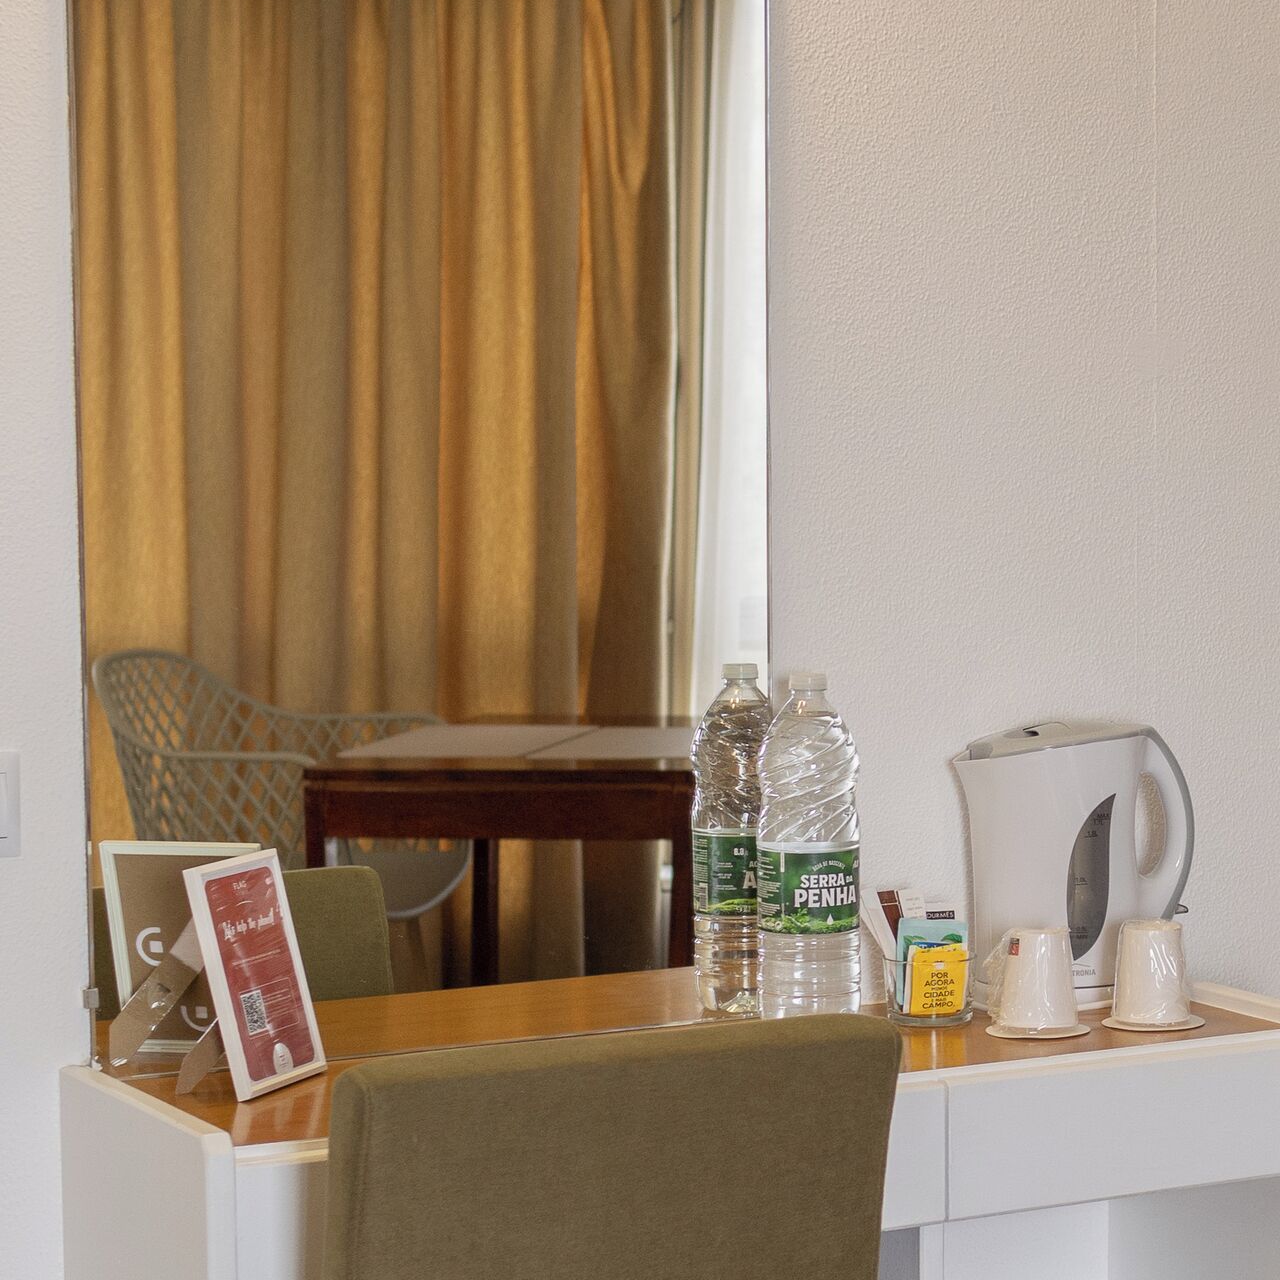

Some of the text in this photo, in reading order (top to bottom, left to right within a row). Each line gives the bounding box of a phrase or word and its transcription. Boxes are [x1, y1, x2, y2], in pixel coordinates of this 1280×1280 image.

[800, 872, 845, 888] SERRA
[794, 884, 857, 908] PENHA
[924, 979, 955, 987] AGORA
[923, 990, 956, 999] CIDADE
